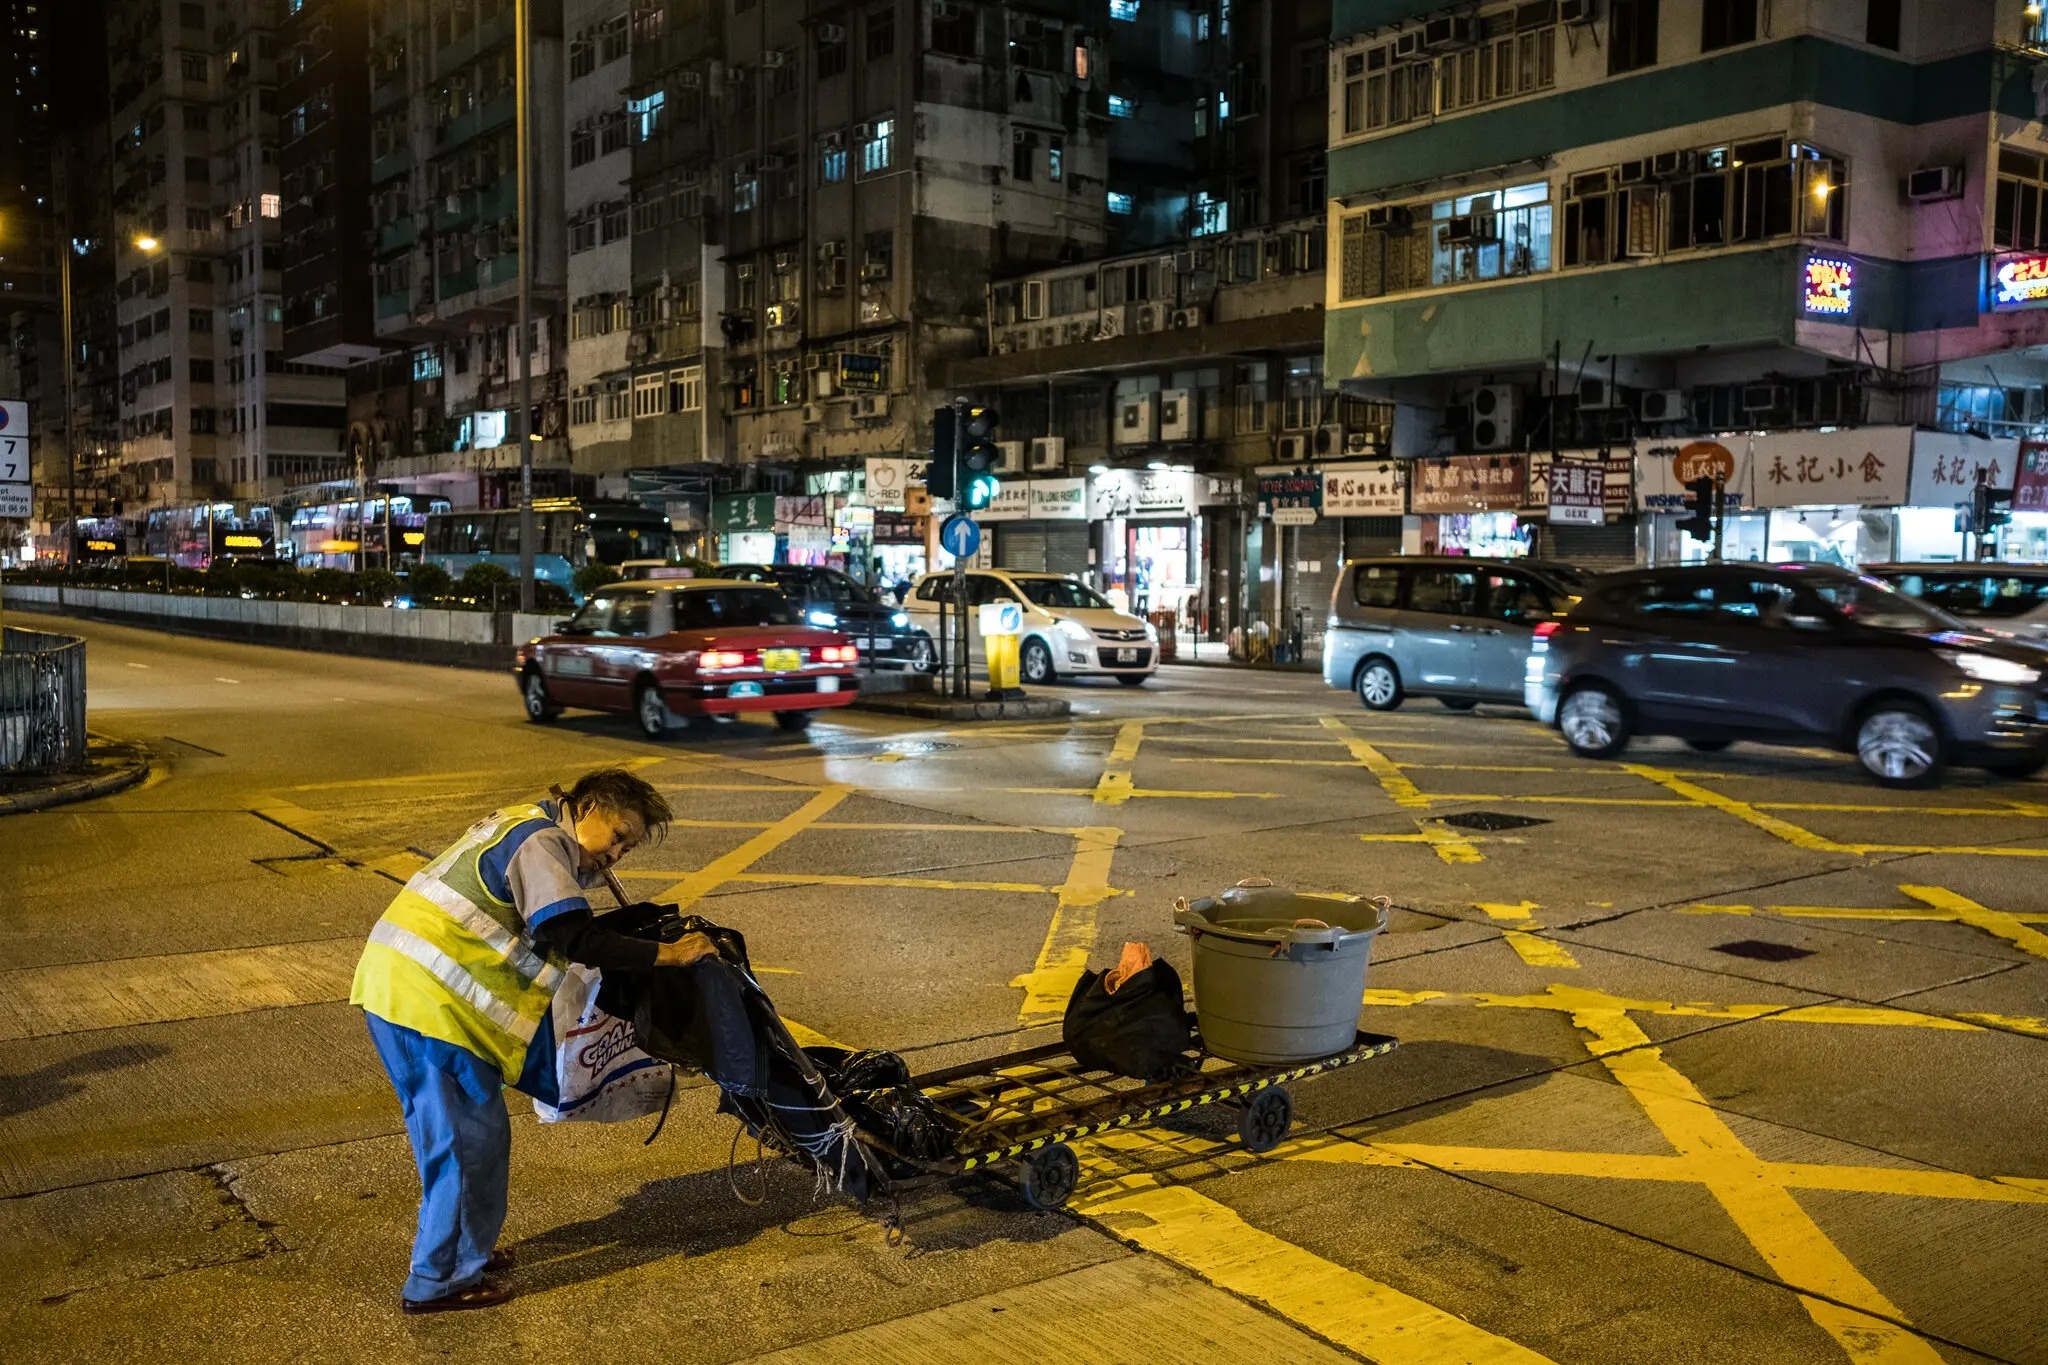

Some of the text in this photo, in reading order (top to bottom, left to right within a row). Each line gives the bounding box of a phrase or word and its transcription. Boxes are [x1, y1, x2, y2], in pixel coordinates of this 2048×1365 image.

[5, 441, 16, 454] 7
[6, 464, 17, 478] 7
[1768, 452, 1885, 485] 永記小食
[1552, 467, 1602, 494] 天龍行
[1530, 491, 1545, 503] SKY
[1564, 508, 1588, 519] GEXE
[581, 1020, 635, 1067] GOAL
[594, 1034, 635, 1076] RUNN
